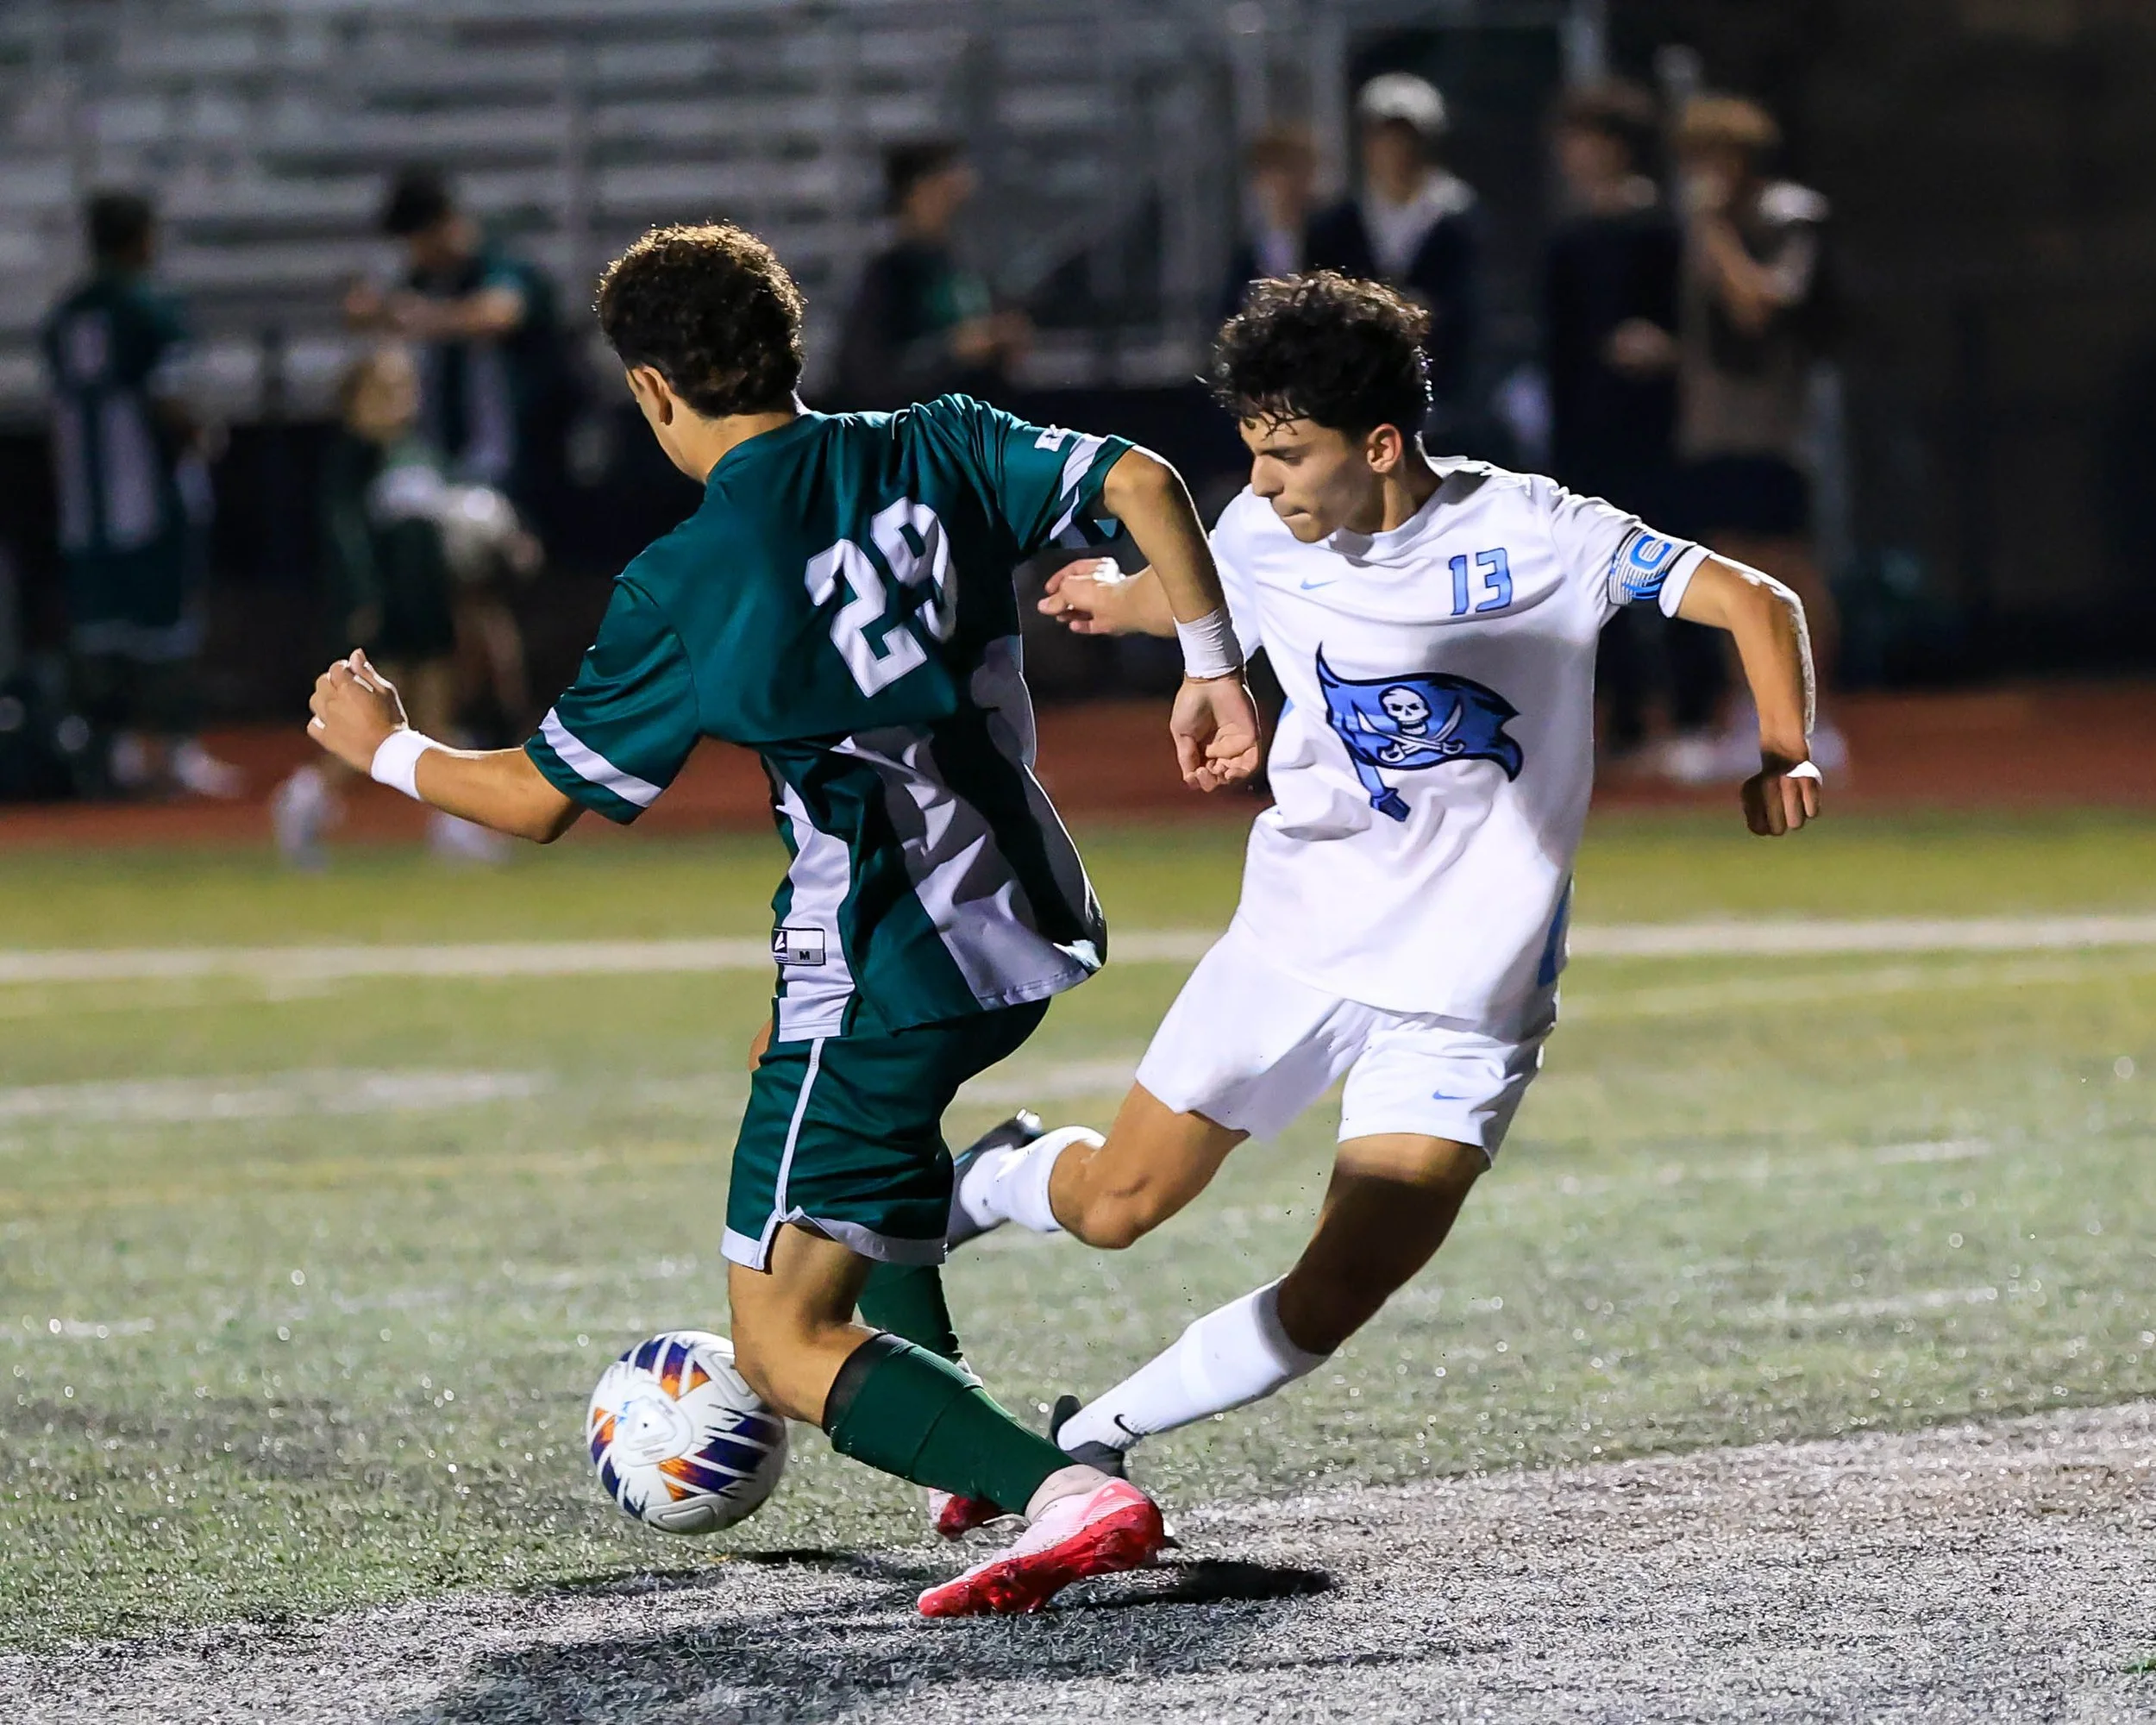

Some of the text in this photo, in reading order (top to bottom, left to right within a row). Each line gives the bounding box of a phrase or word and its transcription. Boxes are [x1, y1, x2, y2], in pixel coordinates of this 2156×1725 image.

[1629, 535, 1672, 570] C
[804, 497, 958, 698] 29
[1448, 547, 1513, 616] 13
[799, 950, 810, 960] M
